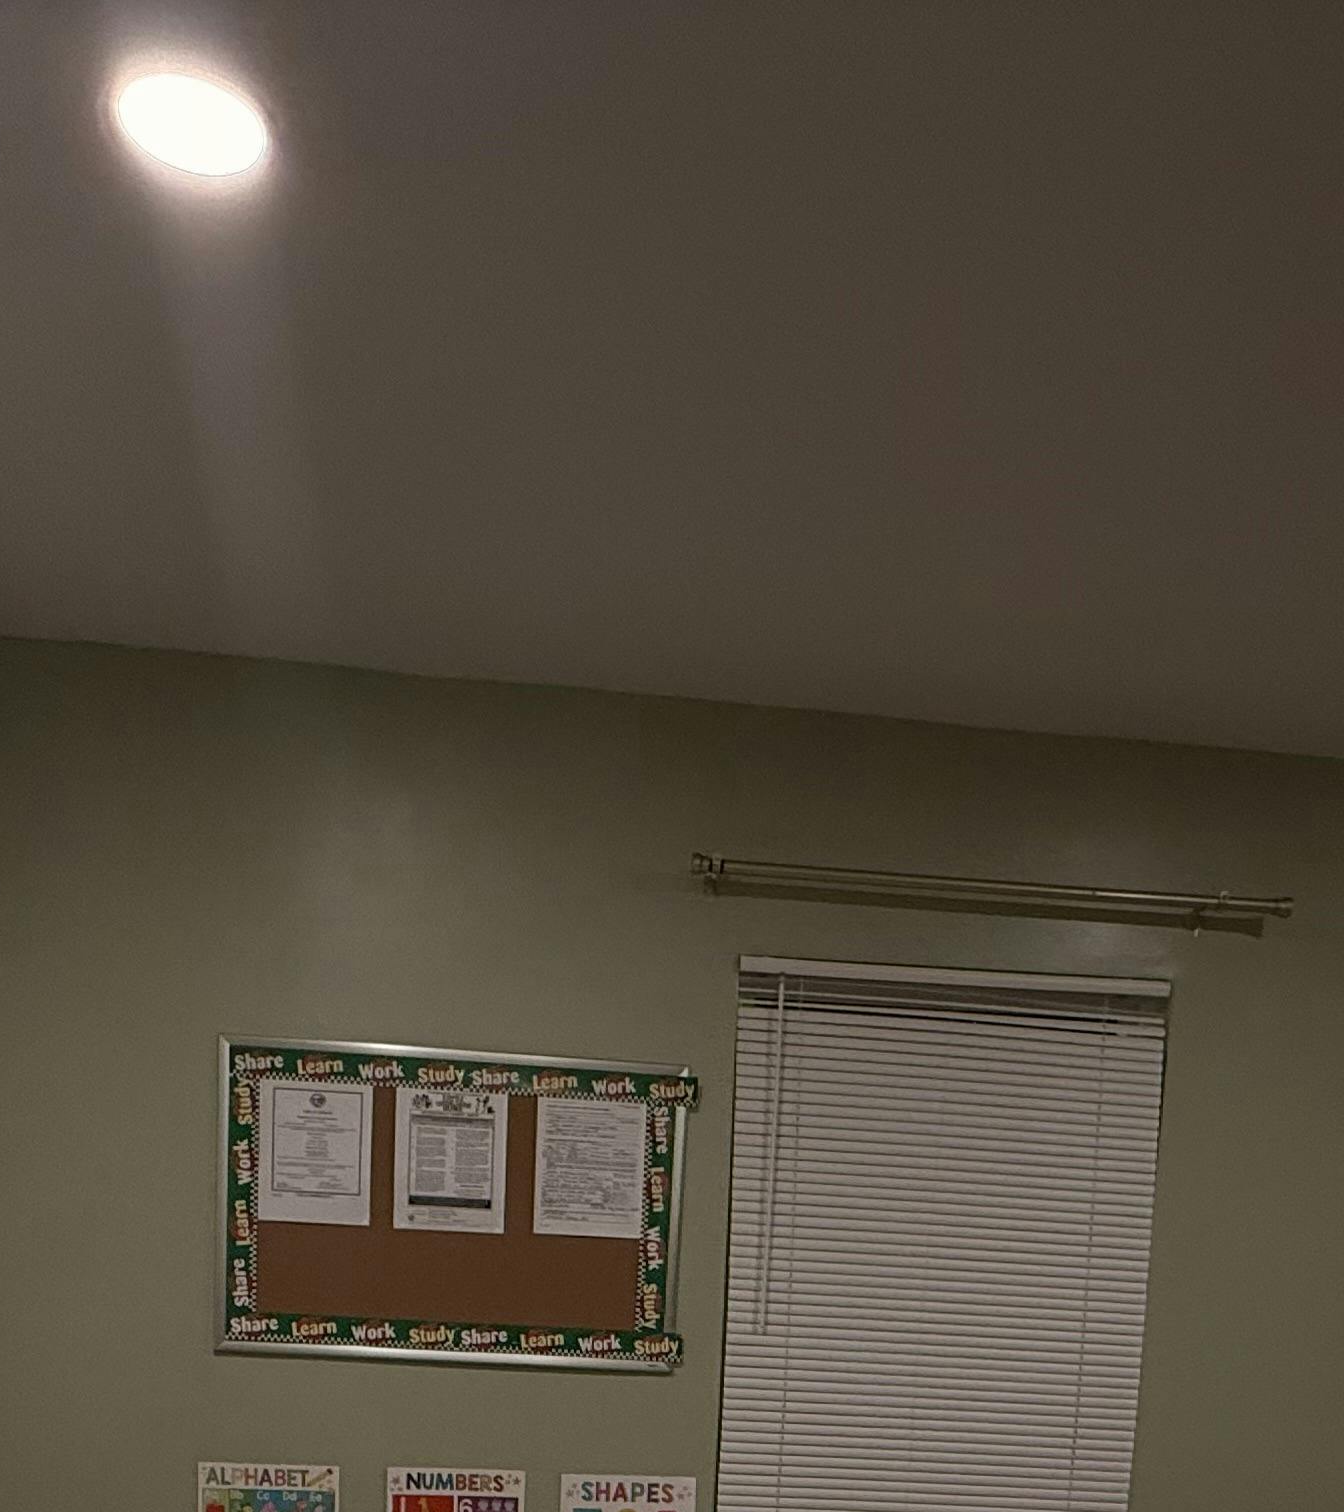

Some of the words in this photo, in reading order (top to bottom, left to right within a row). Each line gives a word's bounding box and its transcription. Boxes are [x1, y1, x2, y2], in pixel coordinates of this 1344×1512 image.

[234, 1053, 284, 1070] Share
[296, 1058, 344, 1075] Learn
[358, 1061, 404, 1080] Work
[417, 1065, 464, 1084] Study
[471, 1068, 521, 1086] Share
[532, 1073, 579, 1091] Learn
[591, 1077, 636, 1095] Work
[649, 1079, 695, 1099] Study
[233, 1076, 253, 1125] Study
[653, 1106, 671, 1154] Share
[233, 1138, 250, 1185] Work
[650, 1167, 665, 1213] Learn
[235, 1200, 250, 1246] Learn
[647, 1226, 664, 1271] Work
[232, 1258, 249, 1307] Share
[642, 1283, 660, 1330] Study
[230, 1316, 279, 1333] Share
[291, 1321, 337, 1338] Learn
[351, 1322, 396, 1341] Work
[409, 1325, 456, 1344] Study
[460, 1327, 508, 1345] Share
[520, 1333, 565, 1350] Learn
[578, 1335, 622, 1352] Work
[634, 1337, 679, 1355] Study
[205, 1466, 309, 1487] ALPHABET
[406, 1472, 505, 1492] NUMBERS
[581, 1481, 675, 1503] SHAPES
